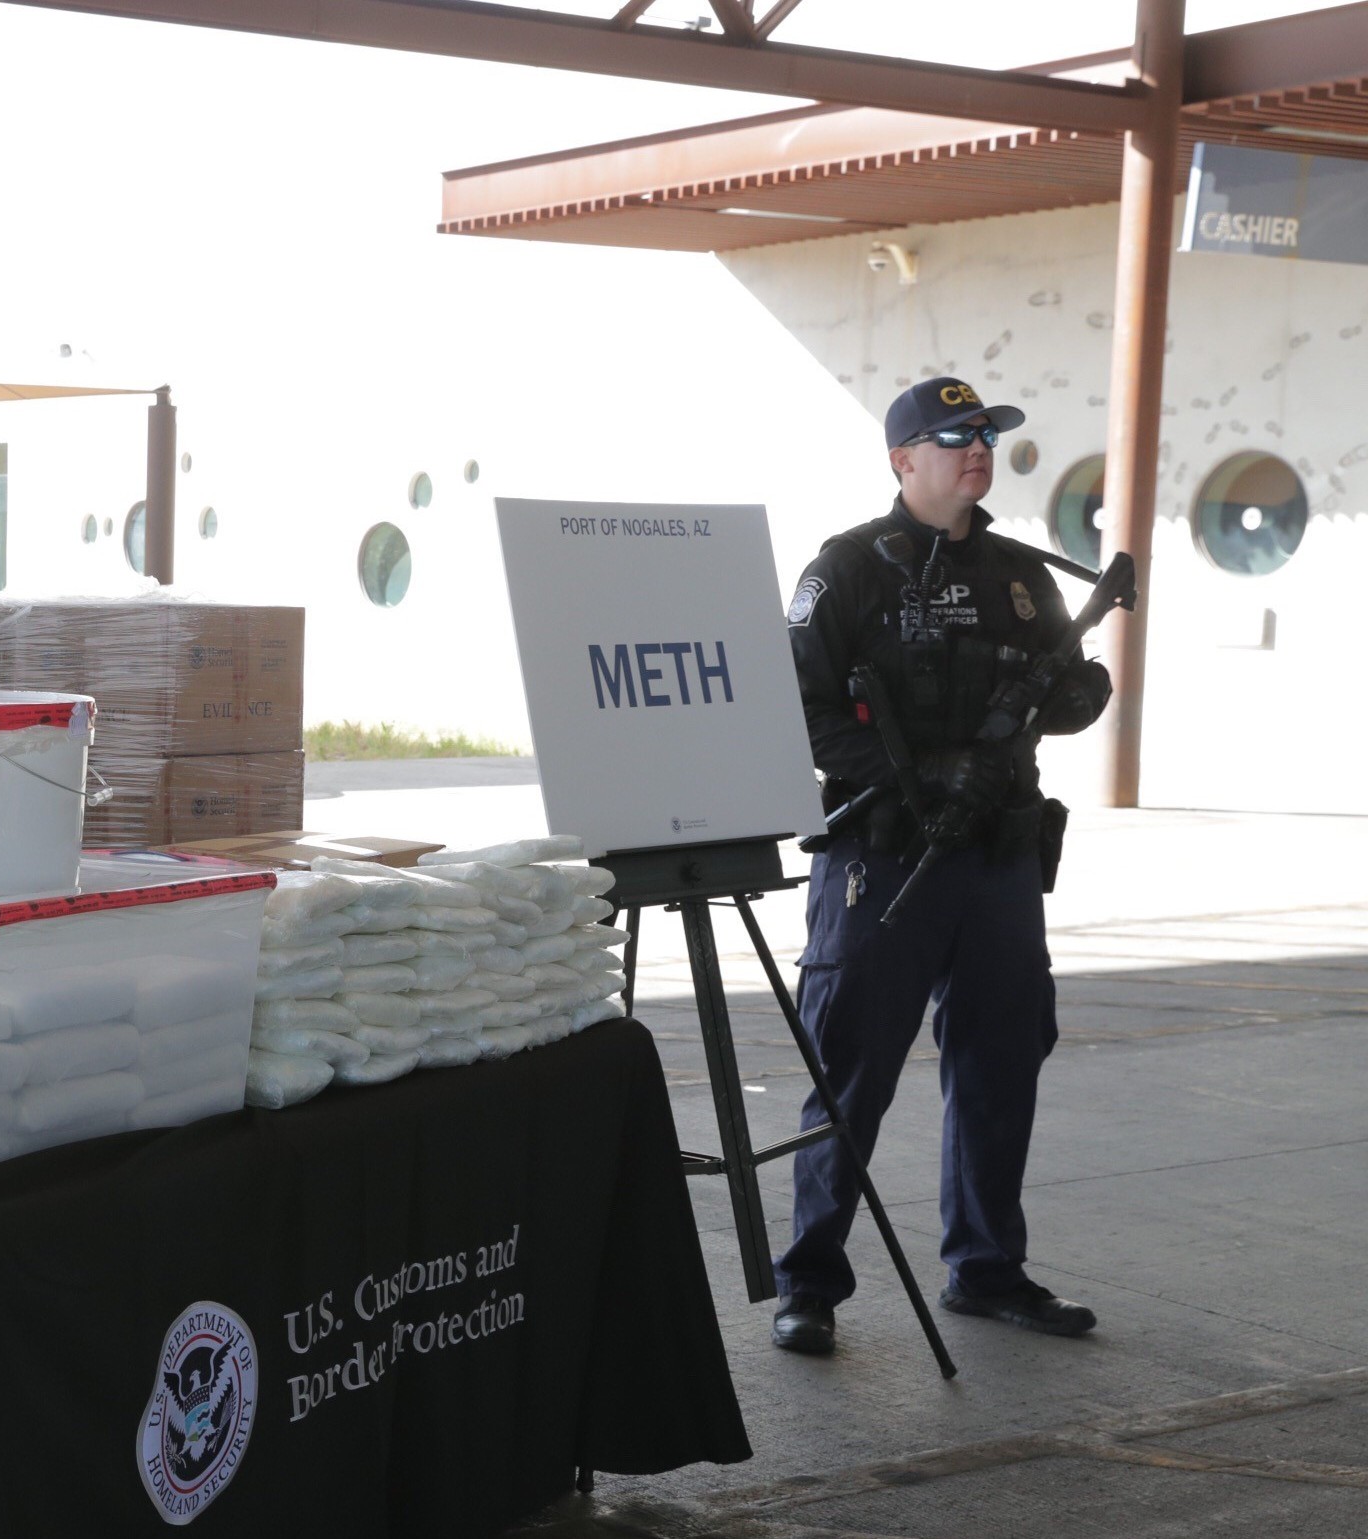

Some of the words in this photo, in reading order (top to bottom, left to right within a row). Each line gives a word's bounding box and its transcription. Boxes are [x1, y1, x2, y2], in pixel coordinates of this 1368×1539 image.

[1199, 212, 1299, 247] CASHIER
[940, 385, 979, 406] CB
[560, 517, 596, 535] PORT
[601, 518, 617, 535] OF
[622, 518, 690, 539] NOGALES,
[694, 519, 712, 536] AZ
[588, 641, 734, 709] METH
[284, 1290, 343, 1354] U.S.
[354, 1251, 468, 1321] Customs
[475, 1224, 519, 1278] and
[148, 1389, 166, 1428] U.S.
[164, 1312, 244, 1371] DEPARTMENT
[238, 1346, 253, 1372] OF
[287, 1341, 386, 1423] Border
[147, 1453, 200, 1515] HOMELAND
[204, 1399, 253, 1501] SECURITY
